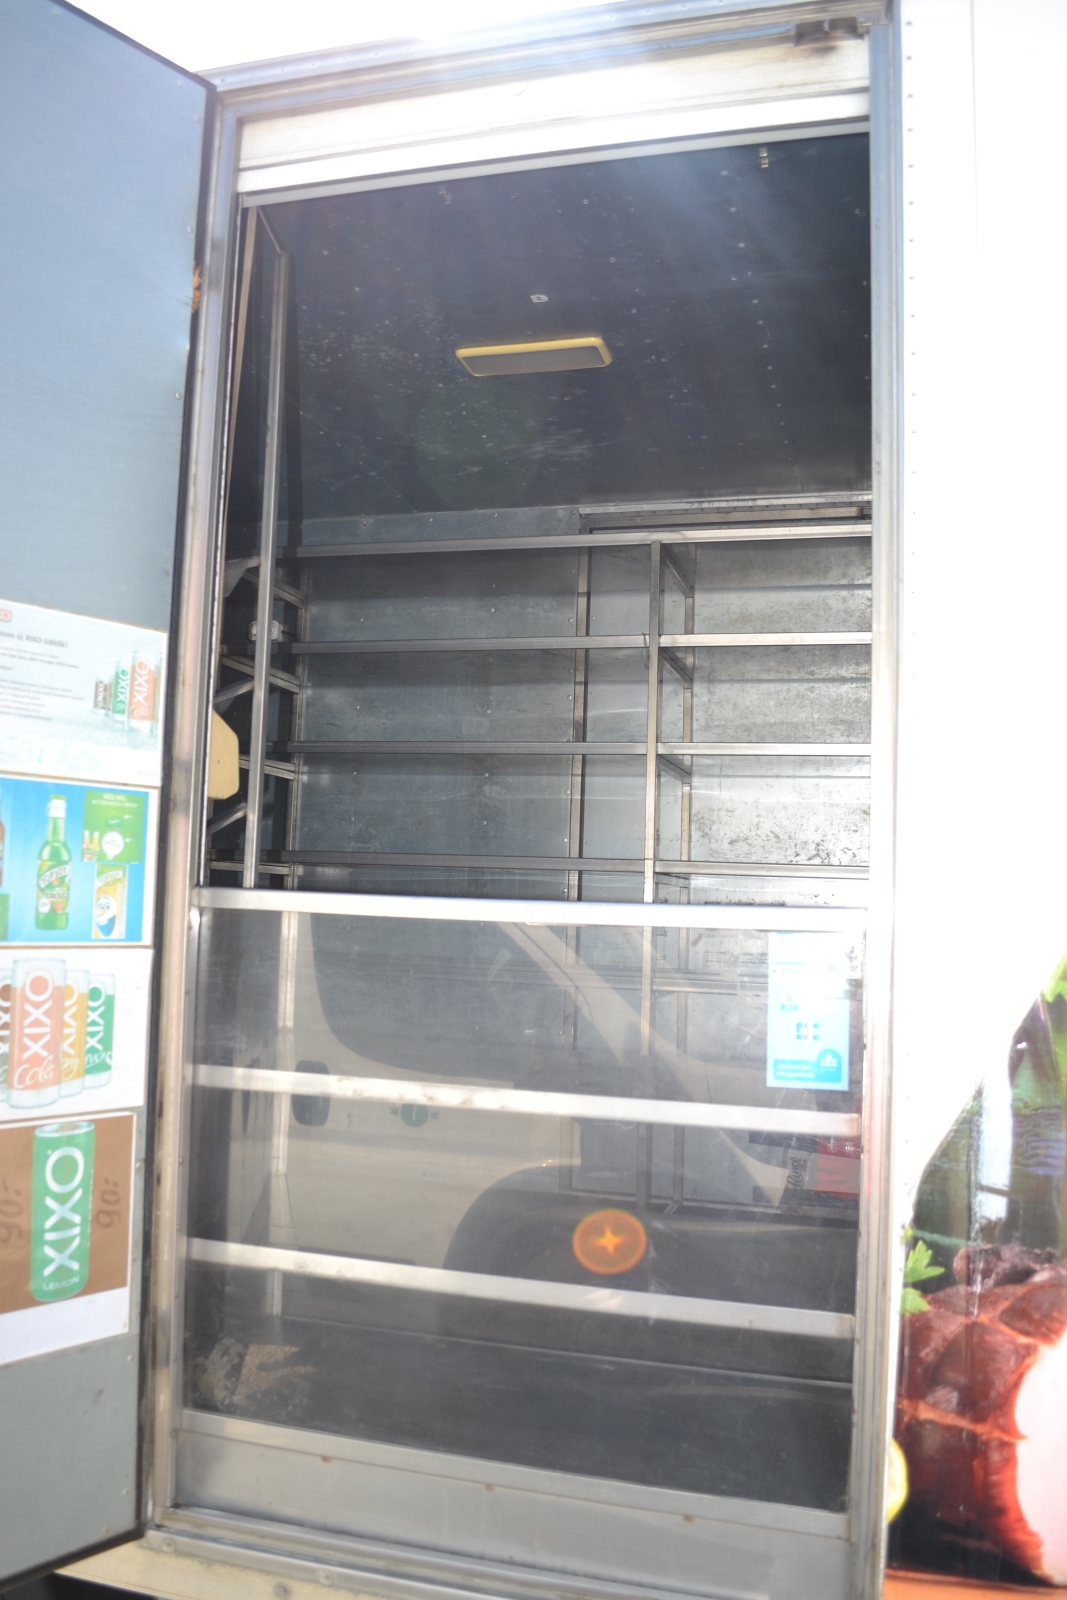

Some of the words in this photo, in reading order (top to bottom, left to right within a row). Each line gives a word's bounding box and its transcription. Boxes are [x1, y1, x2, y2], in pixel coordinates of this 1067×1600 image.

[25, 634, 42, 644] XIXO
[96, 679, 105, 703] XIXO
[117, 668, 129, 704] XIXO
[132, 659, 150, 705] XIXO
[22, 971, 54, 1061] XIXO
[85, 982, 106, 1051] XIXO
[13, 1055, 55, 1089] Cola
[42, 1146, 85, 1277] XIXO
[42, 1275, 80, 1291] LEMON
